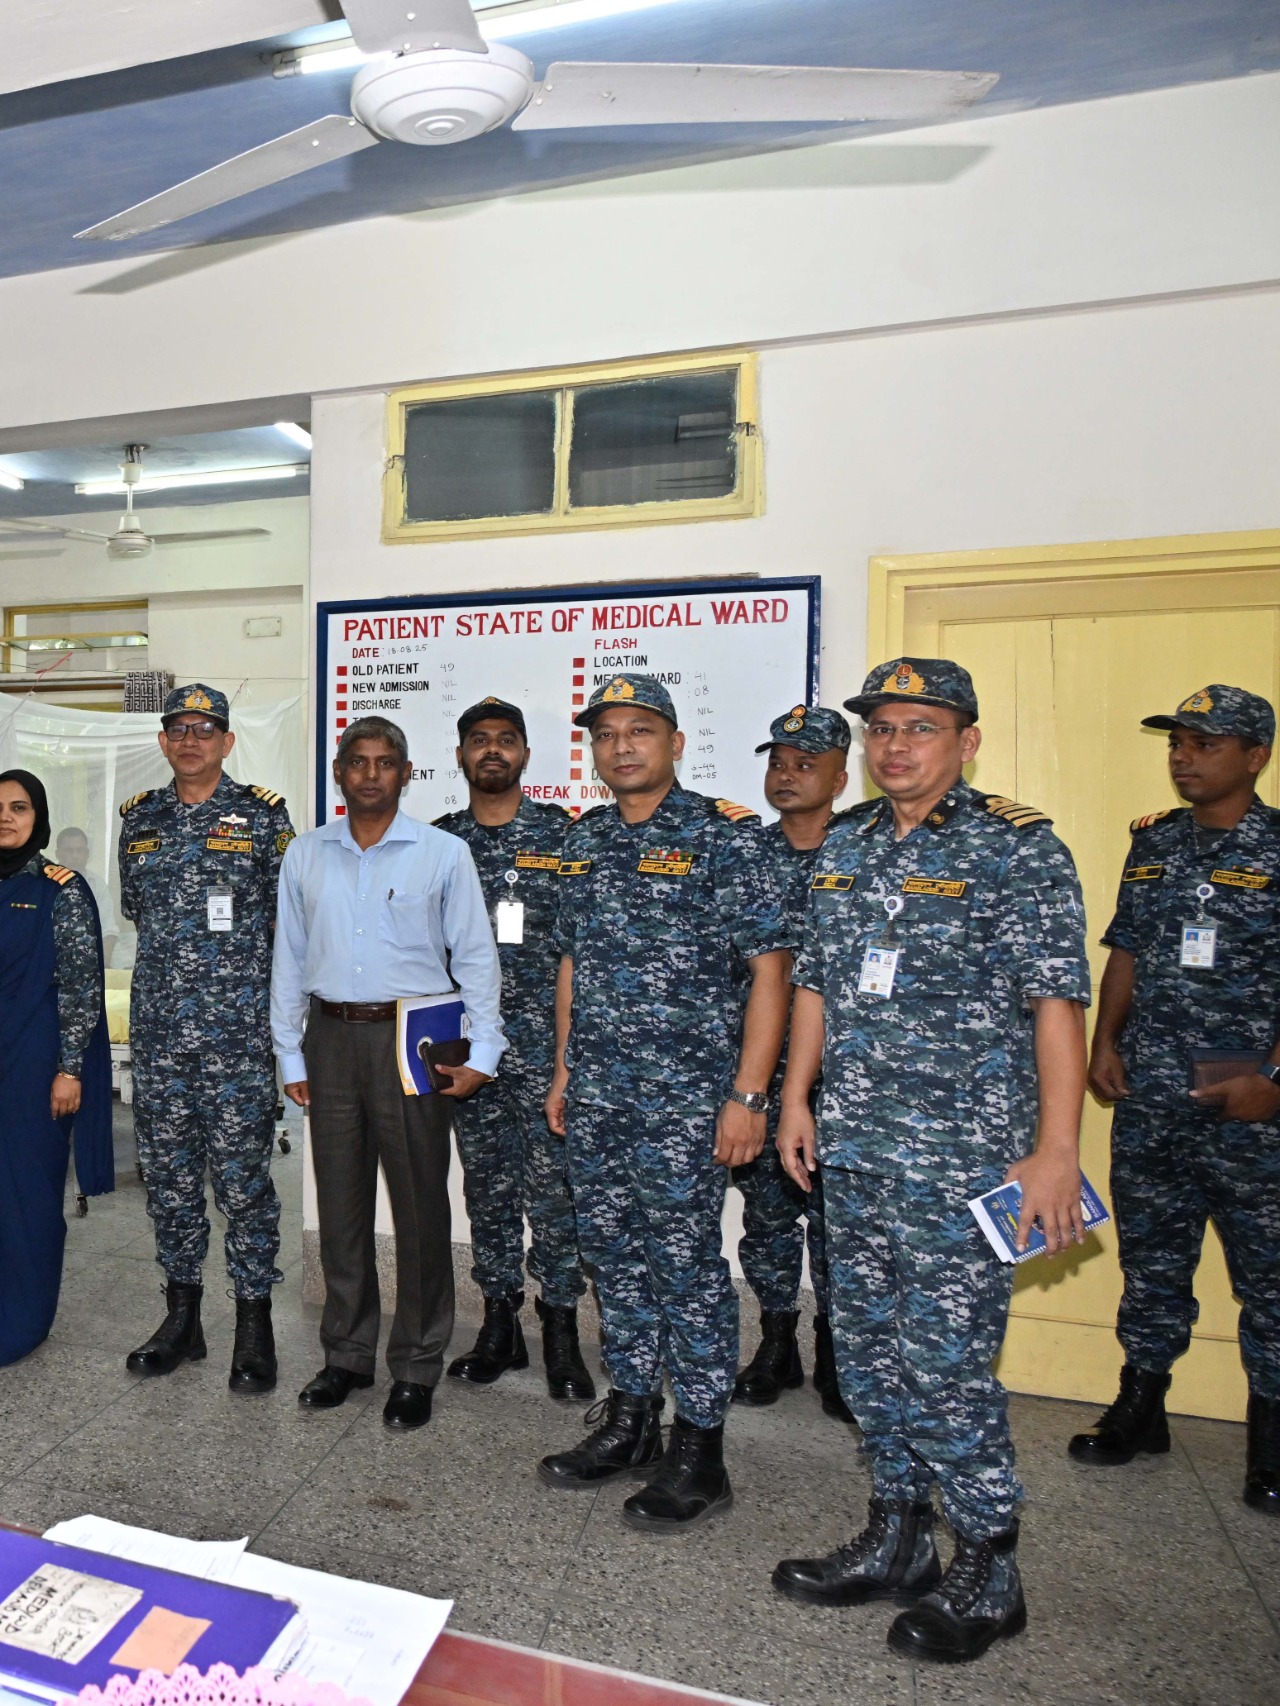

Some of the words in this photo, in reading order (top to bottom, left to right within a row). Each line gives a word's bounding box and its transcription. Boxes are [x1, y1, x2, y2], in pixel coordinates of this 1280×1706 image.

[344, 616, 445, 641] PATIENT
[456, 611, 542, 636] STATE
[551, 607, 585, 632] OF
[592, 602, 702, 630] MEDICAL
[709, 598, 789, 625] WARD
[594, 638, 637, 650] FLASH
[593, 655, 648, 668] LOCATION
[352, 665, 373, 676] OLD
[376, 663, 419, 675] PATIENT
[352, 682, 376, 693] NEW
[379, 681, 429, 692] ADMISSION
[352, 699, 401, 710] DISCHARGE
[697, 707, 714, 715] NIL
[699, 728, 716, 737] NIL
[697, 744, 714, 753] 49
[522, 785, 571, 799] BREAK
[444, 796, 457, 805] 08
